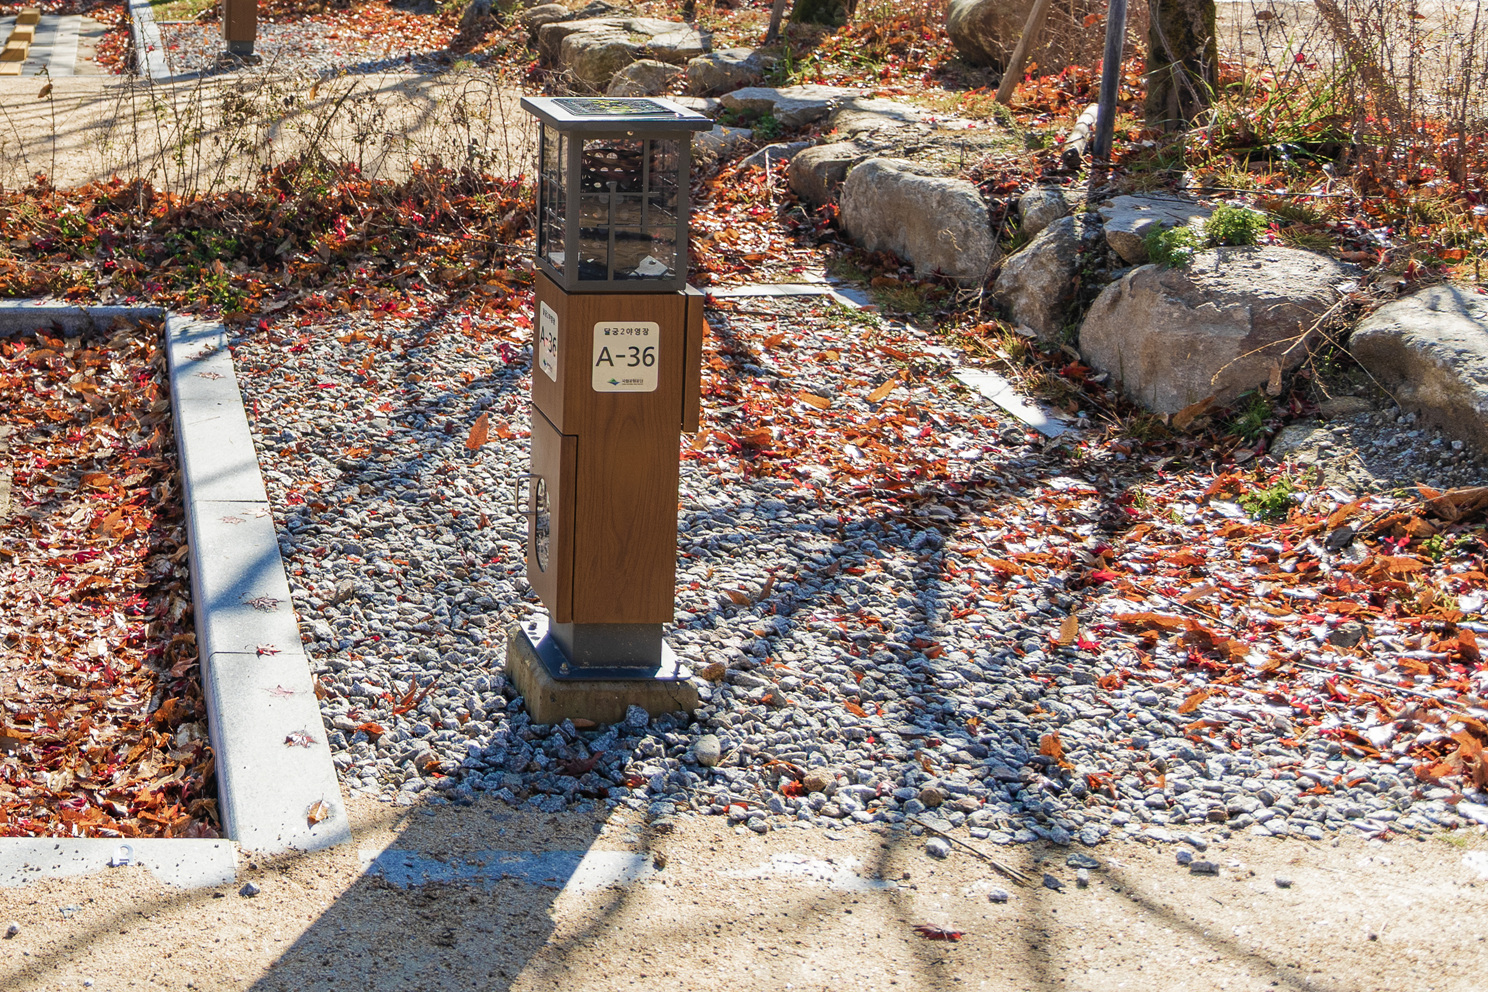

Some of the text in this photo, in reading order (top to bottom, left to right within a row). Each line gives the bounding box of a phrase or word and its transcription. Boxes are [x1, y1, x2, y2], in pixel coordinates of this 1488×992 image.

[539, 325, 557, 358] A-36
[603, 327, 650, 336] 달궁2야영장
[595, 346, 656, 367] A-36
